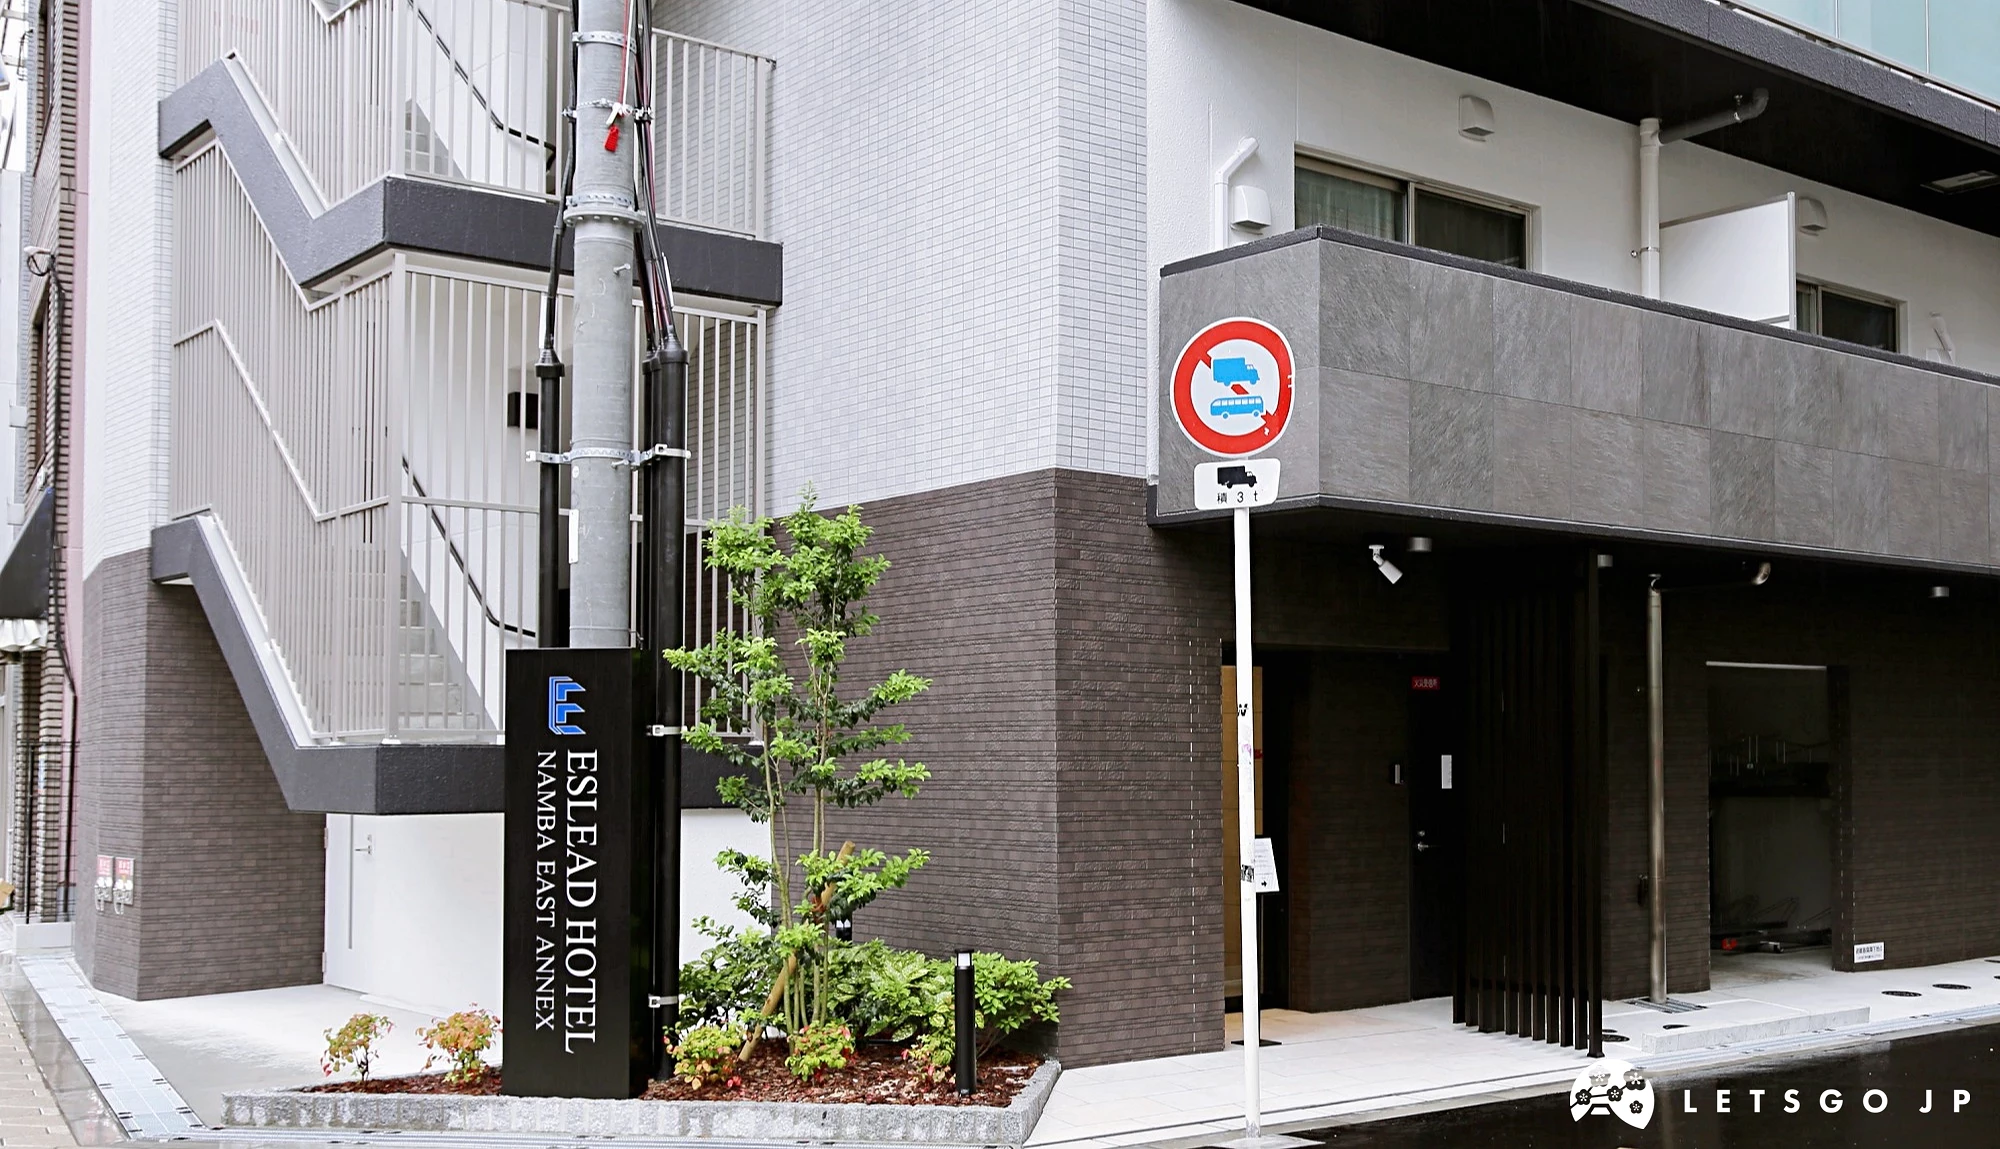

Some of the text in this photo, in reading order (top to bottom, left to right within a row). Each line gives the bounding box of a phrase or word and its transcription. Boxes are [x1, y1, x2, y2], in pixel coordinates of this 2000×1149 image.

[534, 750, 557, 1031] NAMBA EAST ANNEX
[564, 749, 598, 1054] ESLEAD HOTEL
